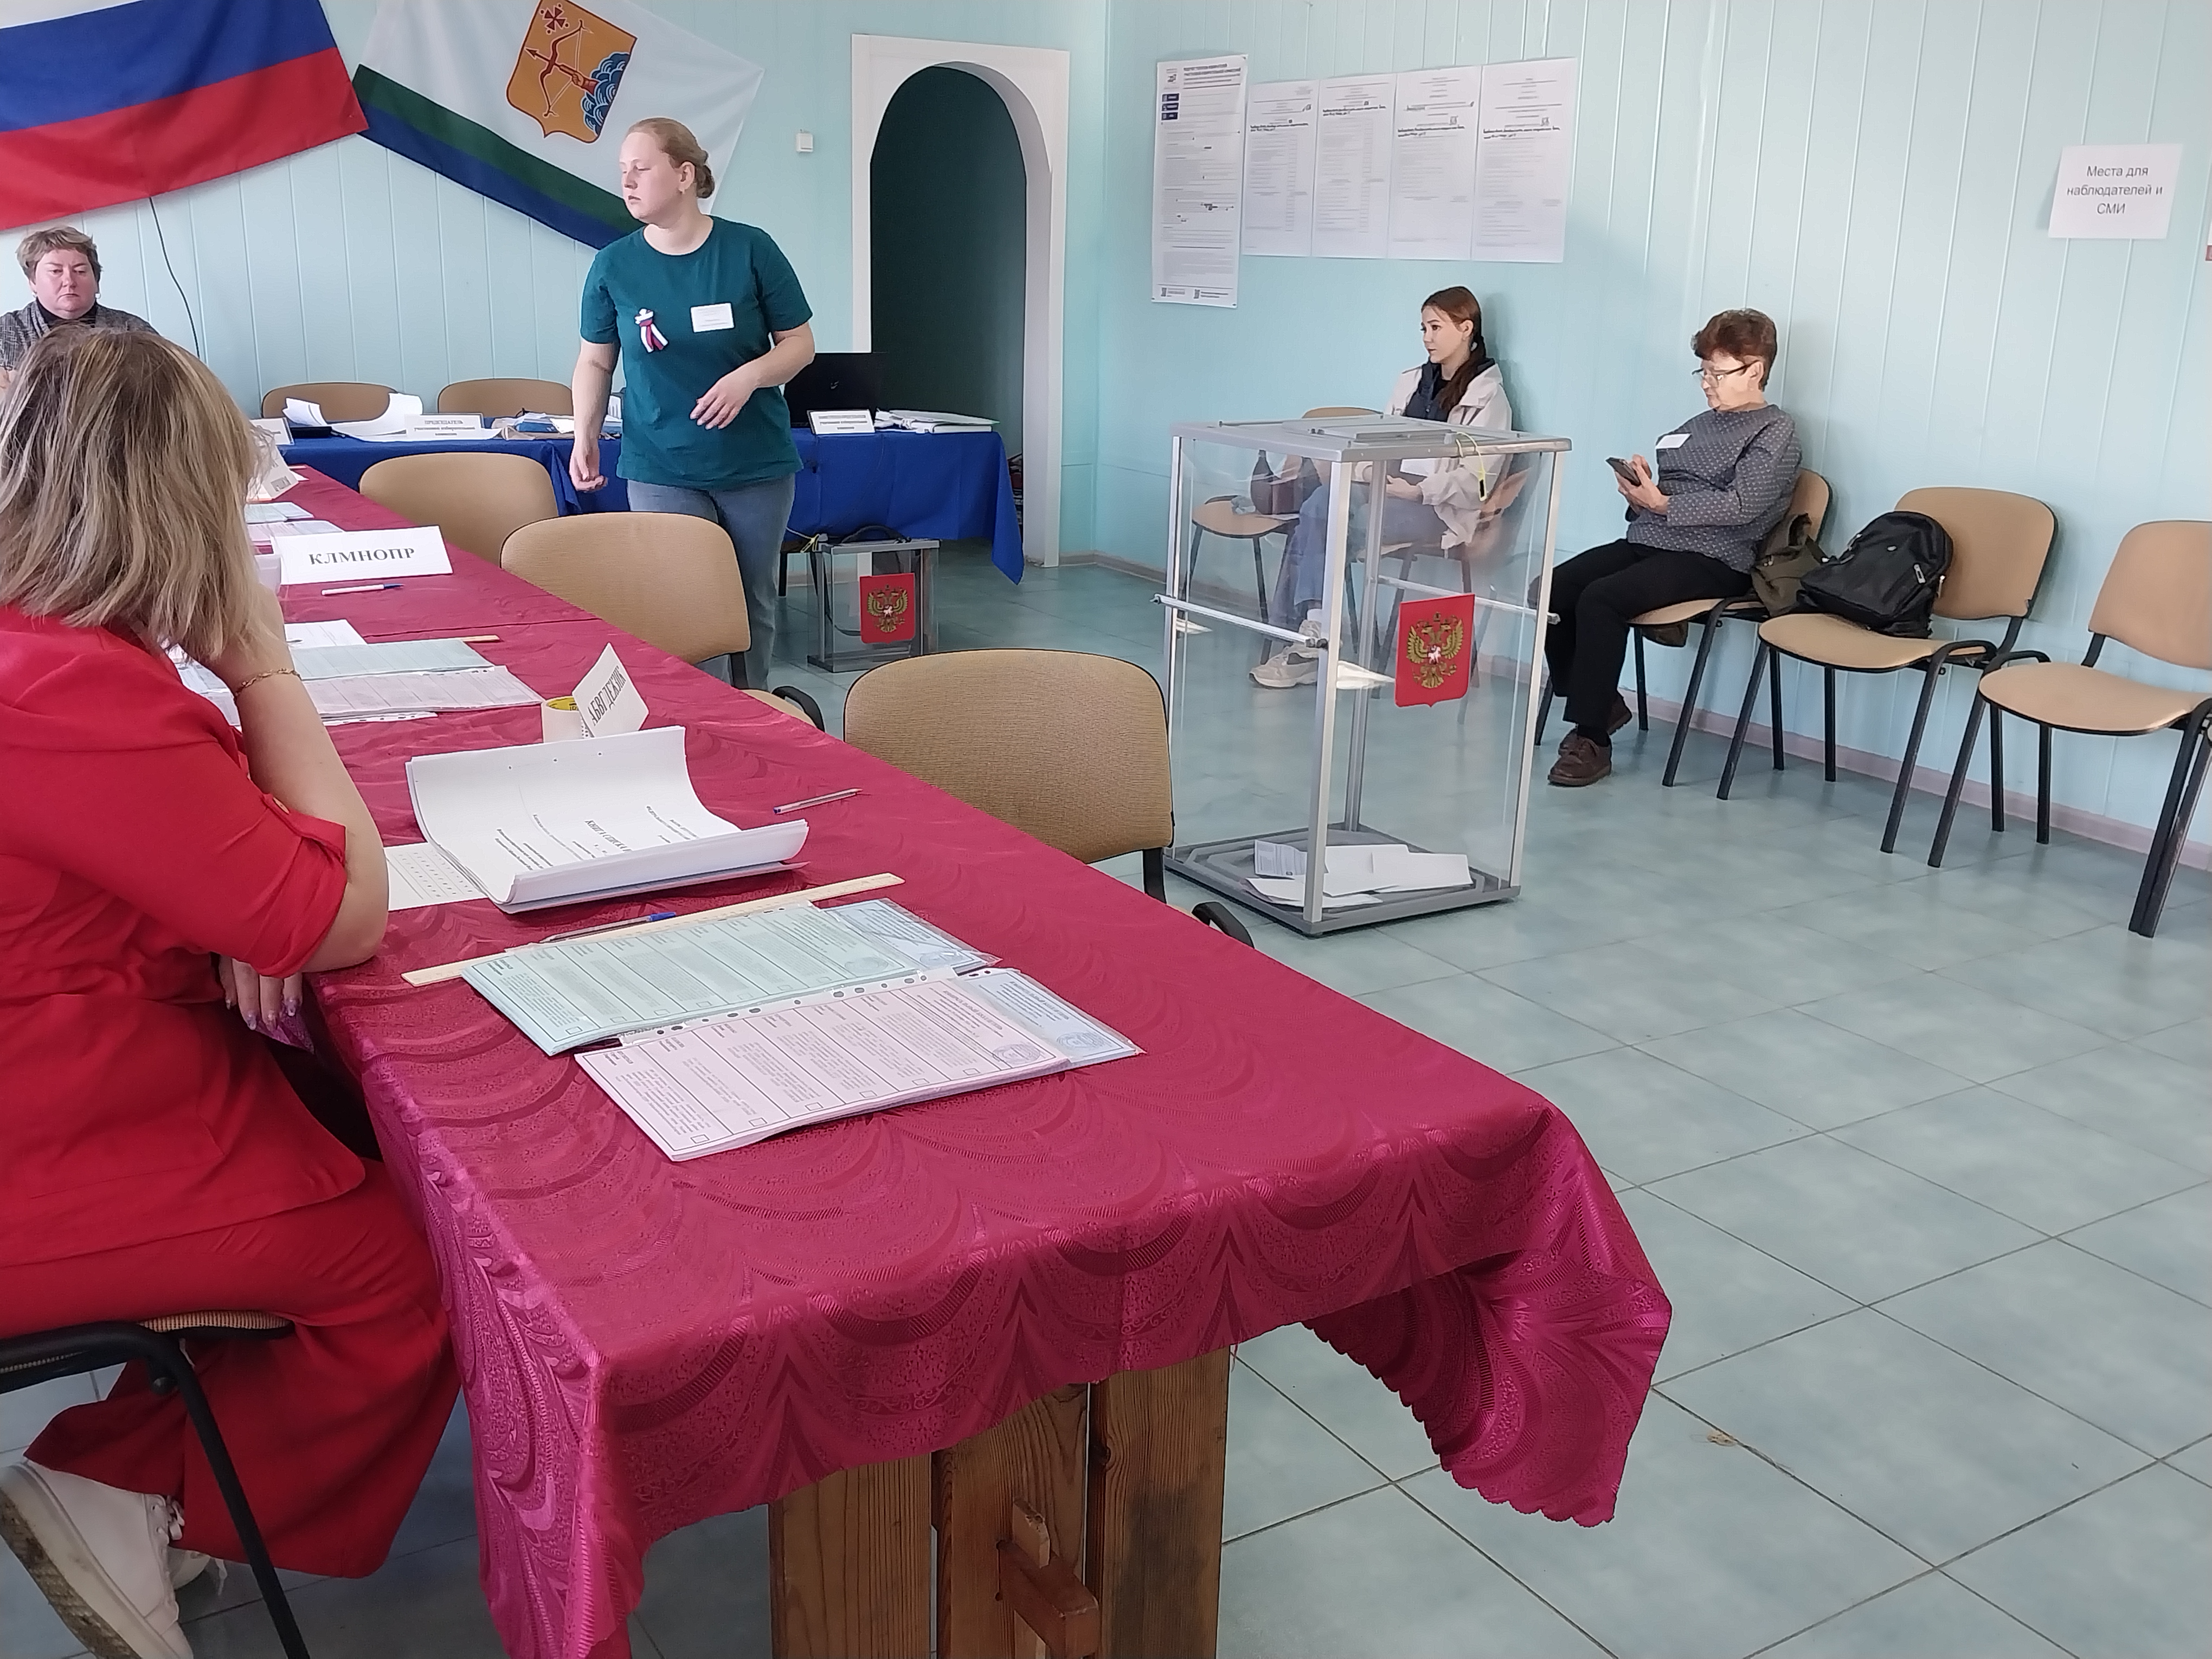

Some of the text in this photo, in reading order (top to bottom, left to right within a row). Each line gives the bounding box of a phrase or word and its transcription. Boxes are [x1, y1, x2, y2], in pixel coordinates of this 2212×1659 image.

[2086, 165, 2149, 178] Места для
[2067, 184, 2163, 197] наблюдателей и
[2097, 203, 2126, 215] СМИ
[308, 548, 415, 565] КЛМНОПР
